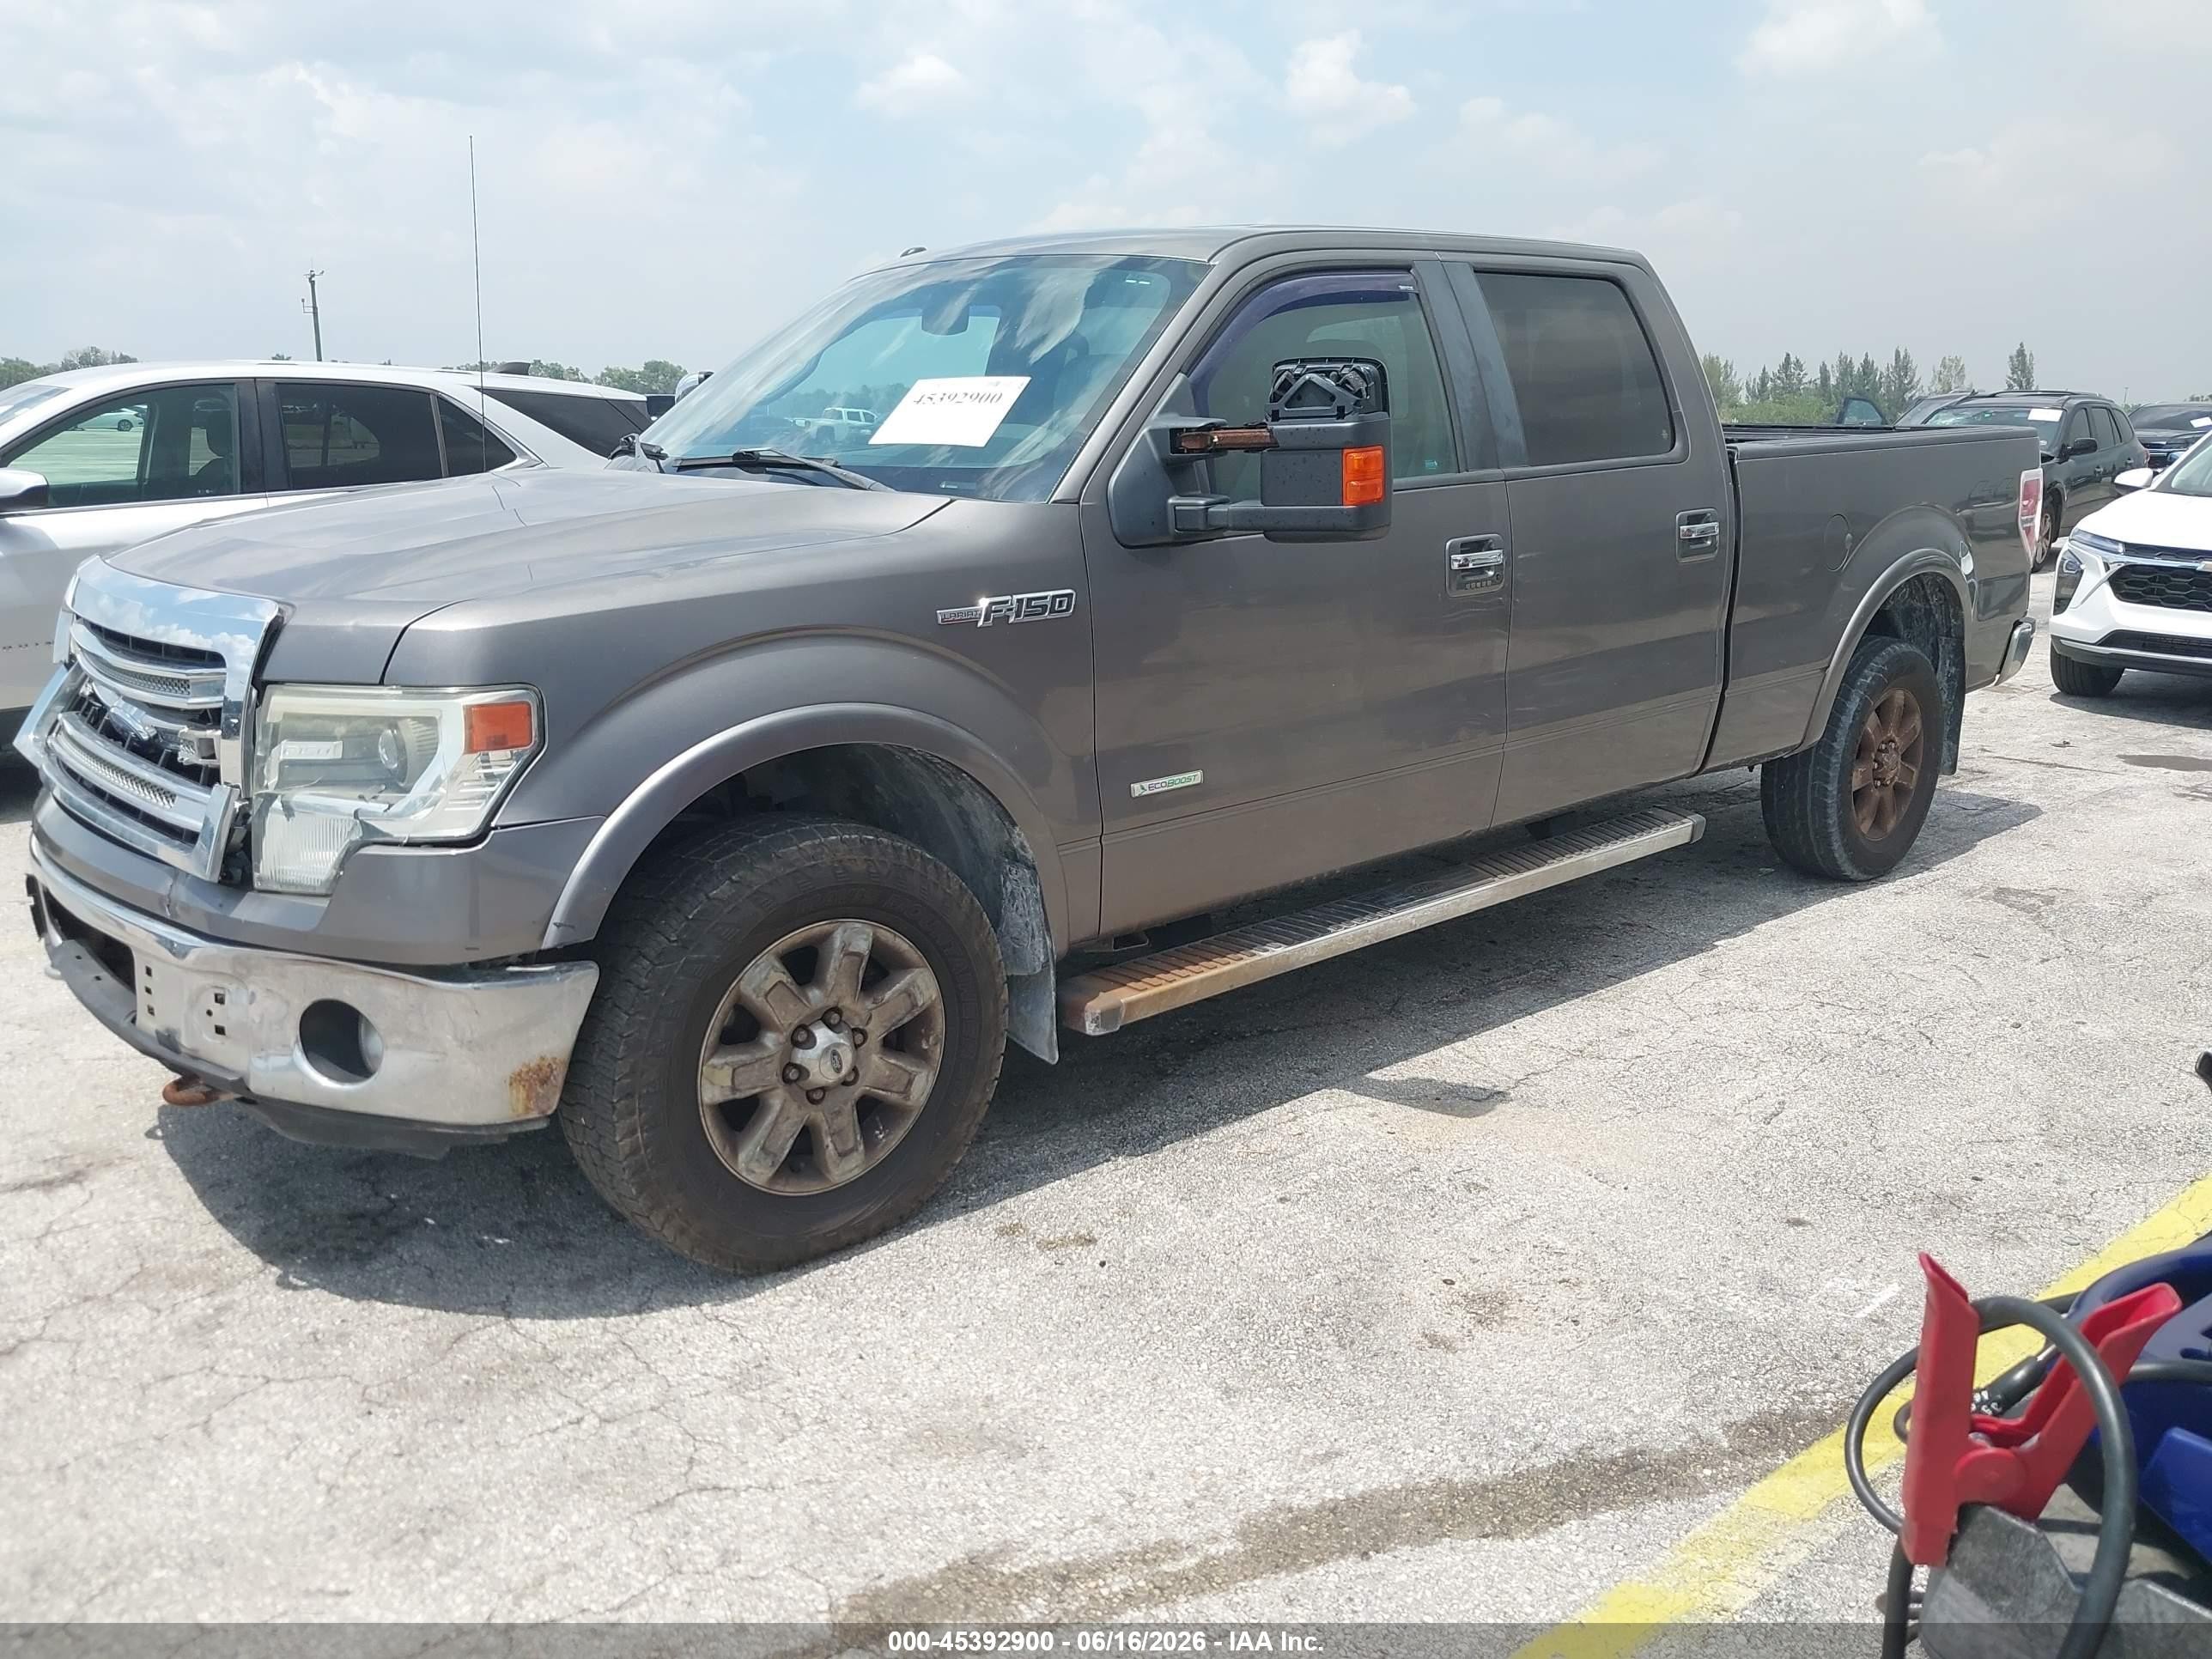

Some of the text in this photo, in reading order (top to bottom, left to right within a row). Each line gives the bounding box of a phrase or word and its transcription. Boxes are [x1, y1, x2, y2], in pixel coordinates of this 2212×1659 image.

[913, 392, 1003, 404] 45392900
[944, 590, 1075, 627] LARIAT F-150
[1148, 775, 1197, 791] ECOBOOST
